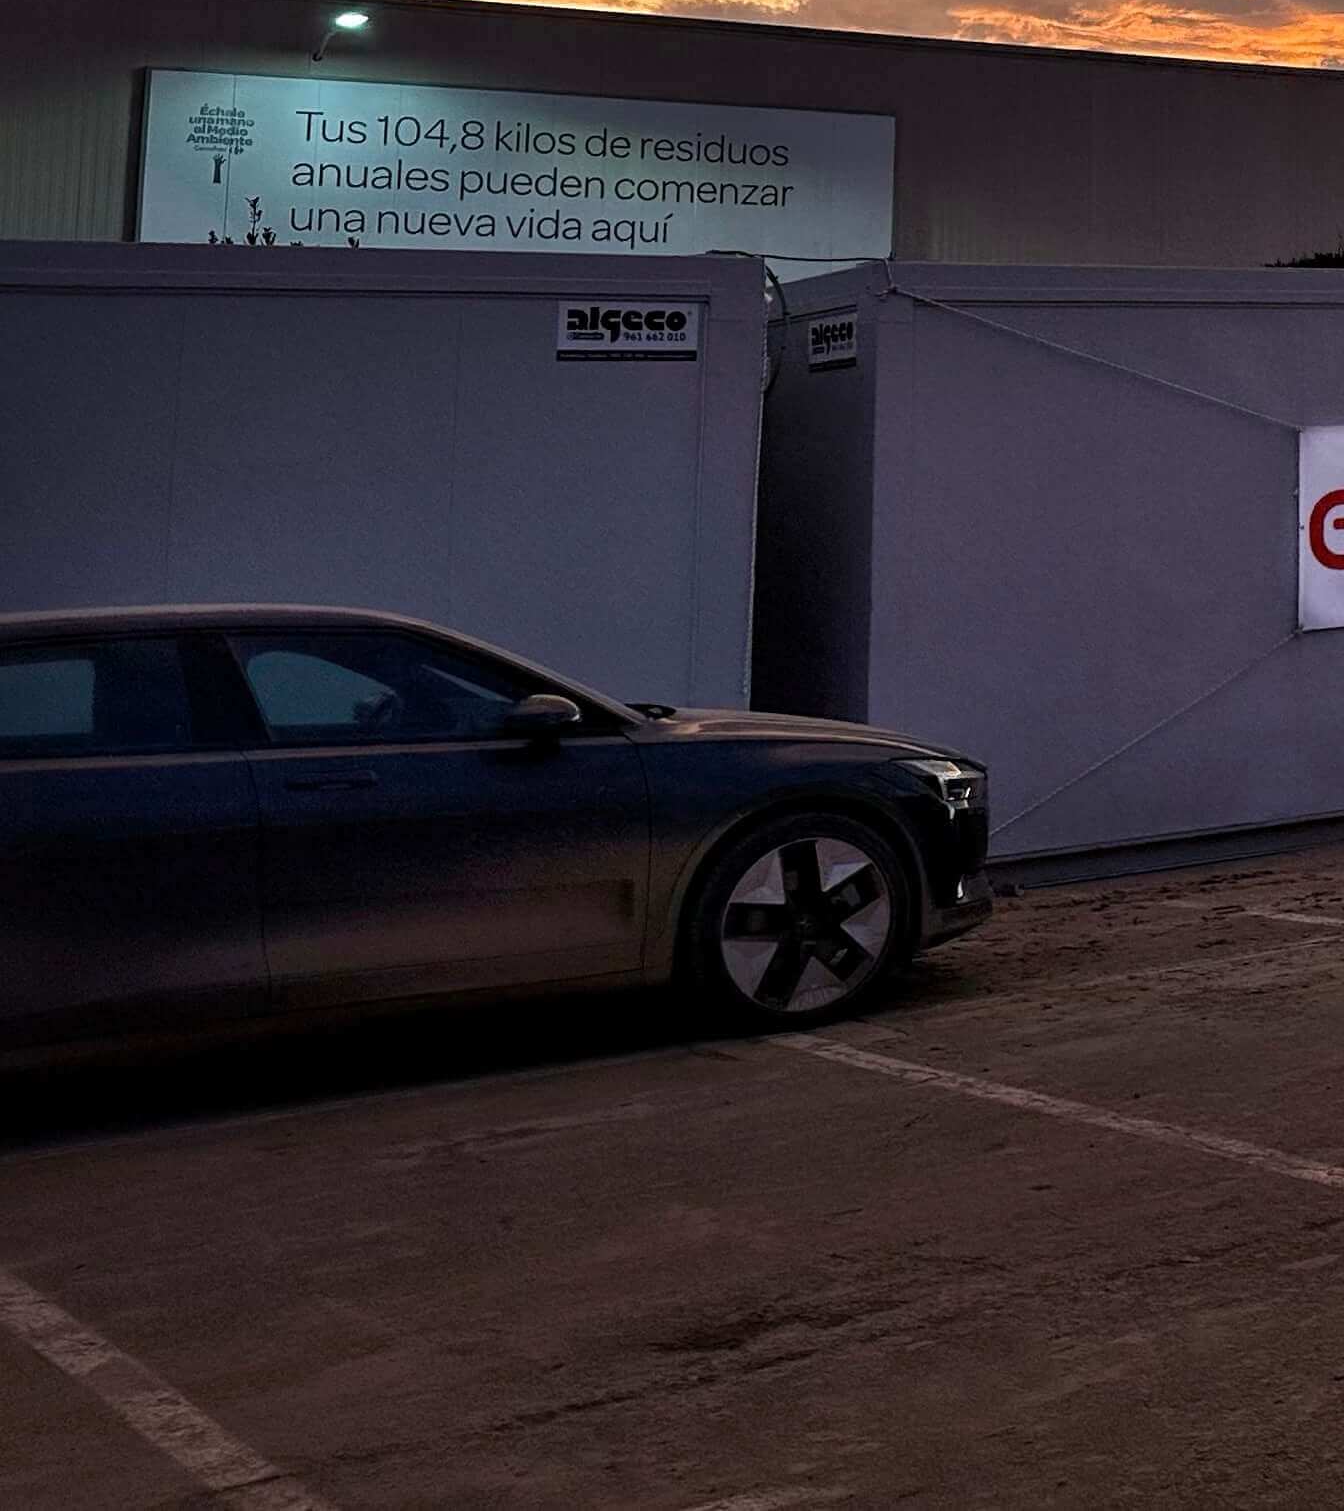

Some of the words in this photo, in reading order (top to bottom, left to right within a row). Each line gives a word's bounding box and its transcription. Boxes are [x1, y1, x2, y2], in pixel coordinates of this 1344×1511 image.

[295, 110, 368, 144] Tus
[376, 115, 485, 155] 104,8
[494, 120, 576, 156] kilos
[584, 127, 631, 158] de
[640, 132, 790, 166] residuos
[291, 158, 450, 192] anuales
[459, 167, 604, 201] pueden
[614, 177, 795, 207] comenzar
[289, 206, 366, 233] una
[376, 210, 496, 236] nueva
[506, 207, 582, 240] vida
[591, 212, 674, 250] aquí
